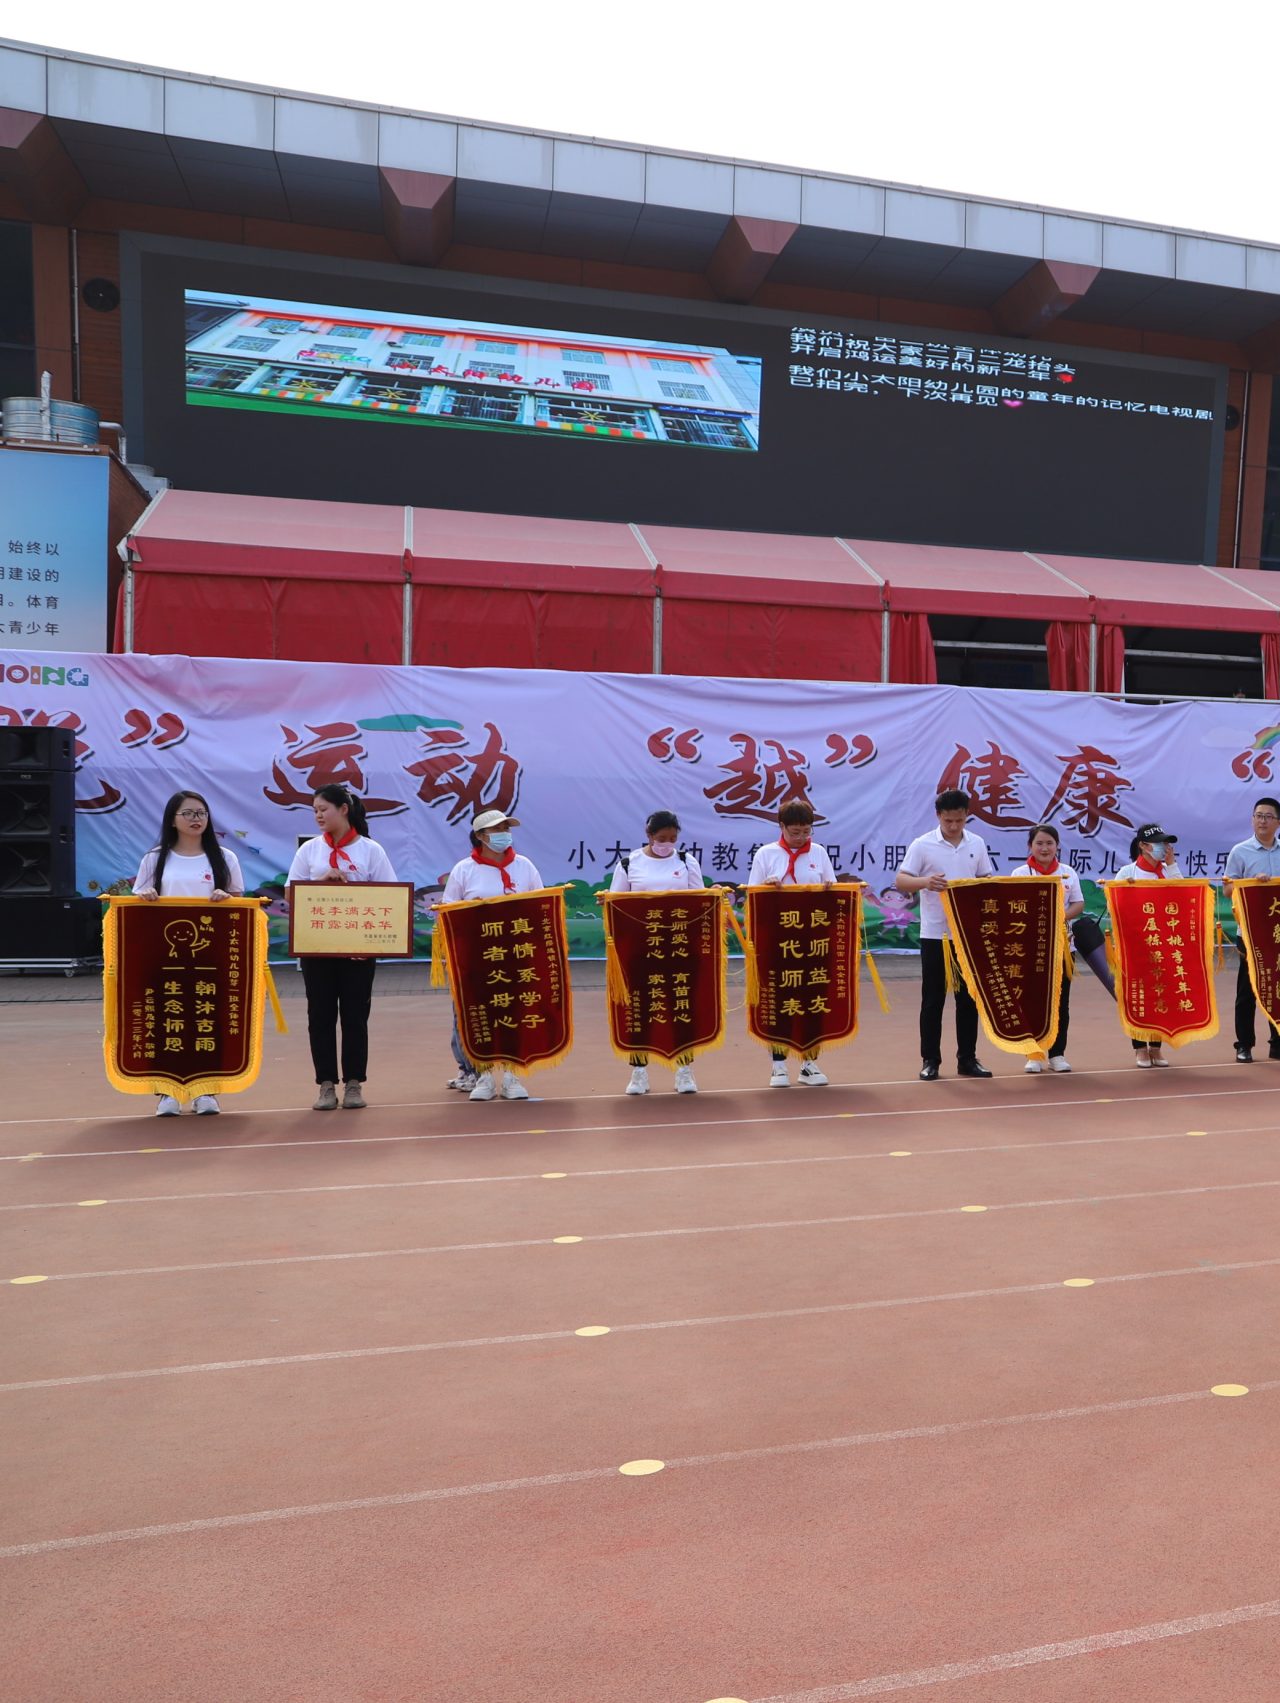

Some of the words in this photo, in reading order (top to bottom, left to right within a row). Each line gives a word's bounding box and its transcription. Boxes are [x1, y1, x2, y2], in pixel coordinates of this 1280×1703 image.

[790, 344, 1052, 382] 开启鸿运美好的新一年
[8, 538, 60, 557] 始终以
[0, 594, 60, 611] 。体育
[936, 739, 1136, 838] 健康
[309, 905, 394, 917] 桃李满天下
[309, 918, 394, 931] 雨露润春华
[644, 908, 666, 961] 孩子开心
[670, 907, 690, 959] 老师爱心
[479, 920, 519, 1030] 师者父母心
[509, 917, 547, 1030] 真情系学子
[778, 909, 805, 1017] 现代师表
[806, 908, 832, 1014] 良师益友
[161, 965, 186, 1053] 一生念师恩
[647, 973, 668, 1025] 家长放心
[671, 971, 692, 1025] 育苗用心
[131, 1000, 144, 1060] 二零二三年六月
